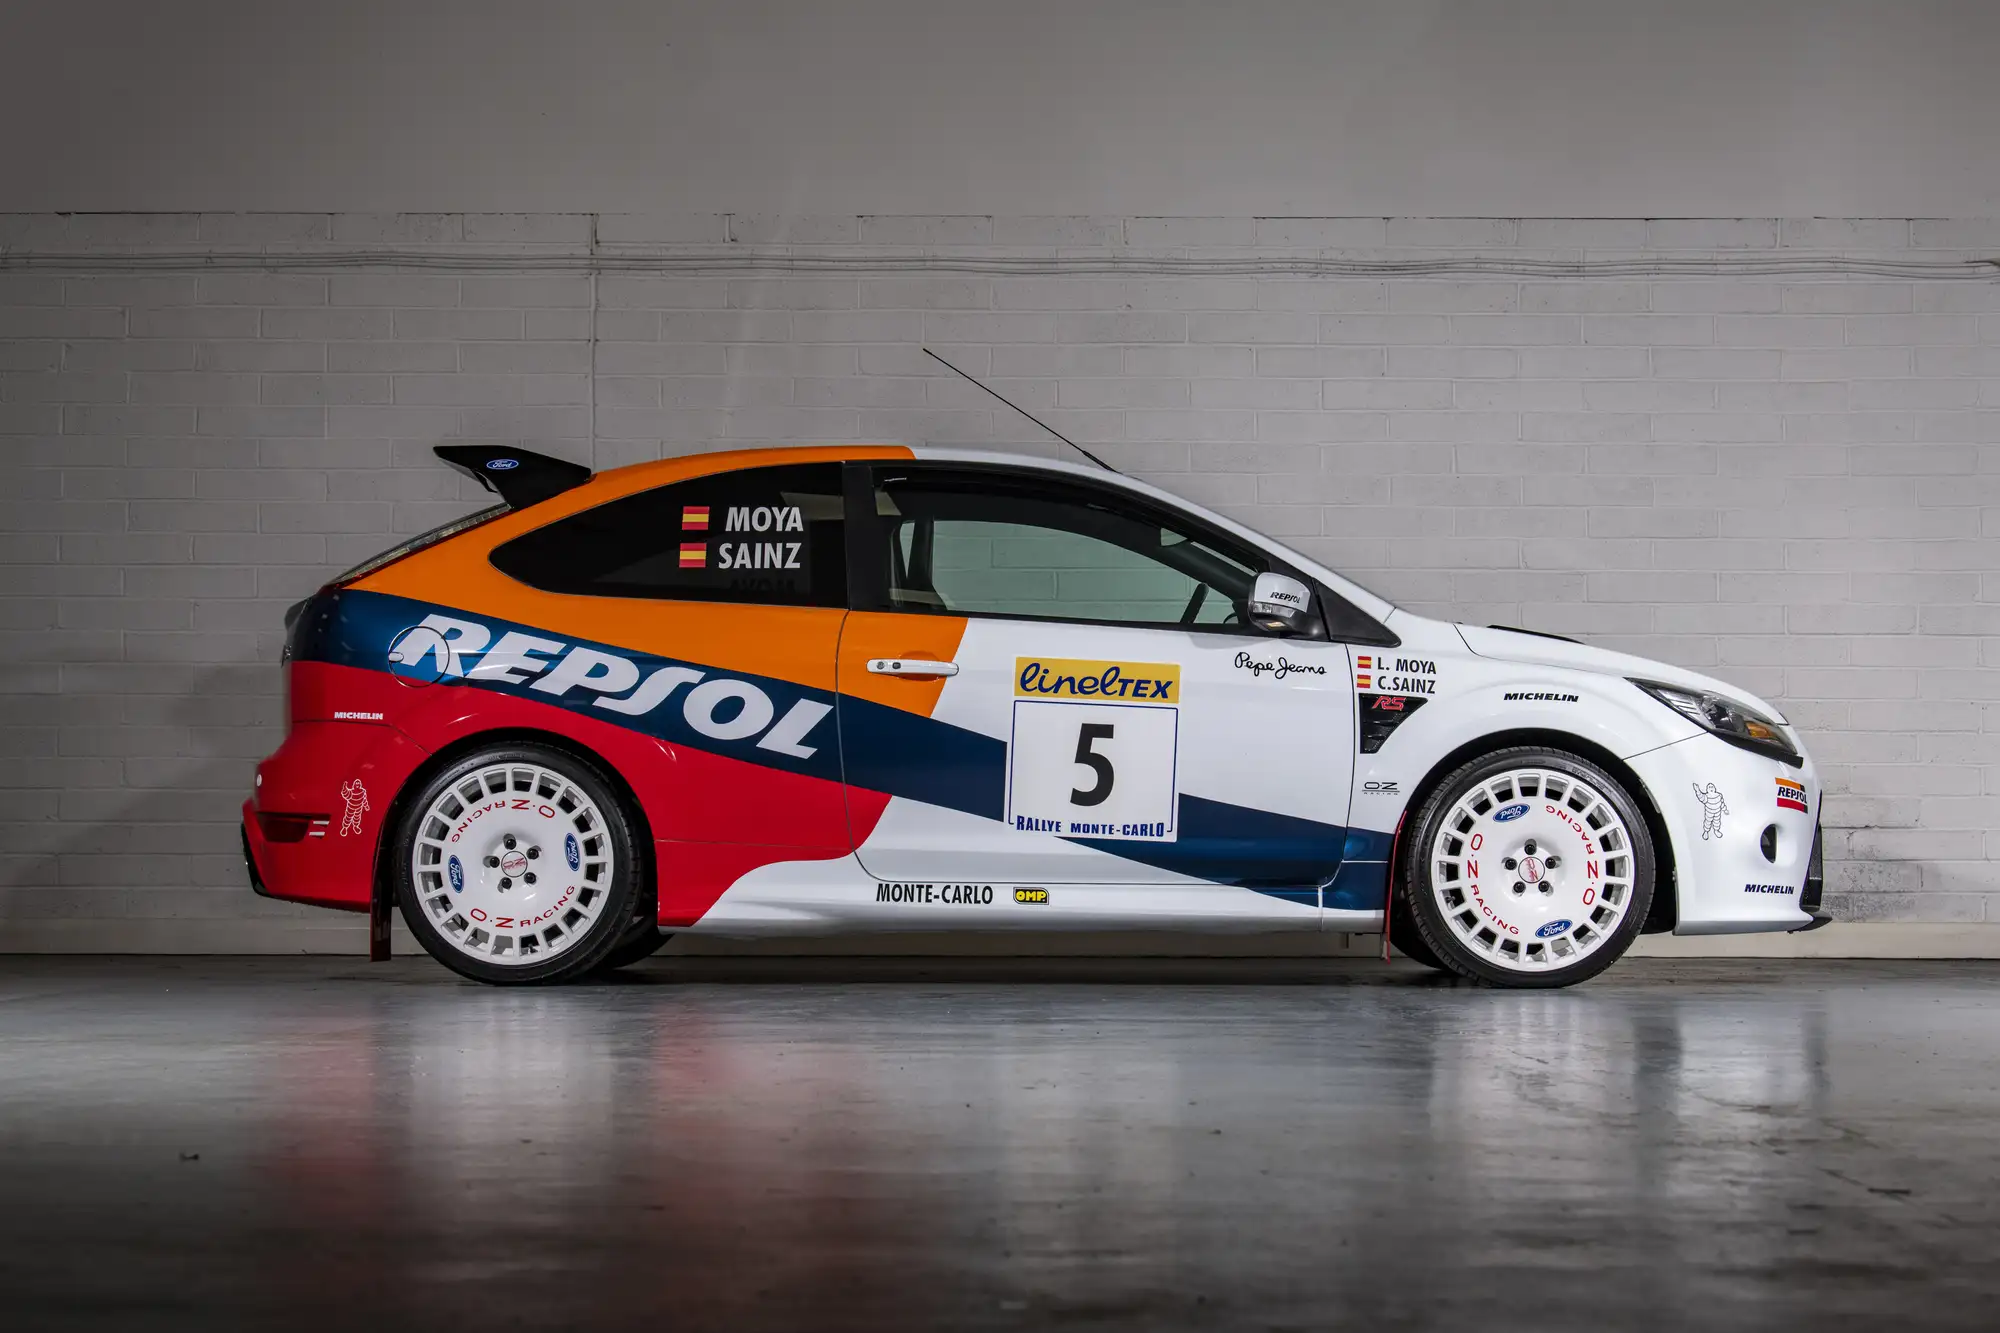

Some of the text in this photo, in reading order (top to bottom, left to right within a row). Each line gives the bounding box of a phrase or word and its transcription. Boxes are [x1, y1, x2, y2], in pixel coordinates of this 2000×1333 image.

[725, 506, 804, 532] MOYA
[718, 542, 802, 569] SAINZ
[1270, 592, 1300, 604] REPSOL
[1234, 652, 1327, 679] Pepe Jeans
[1378, 657, 1436, 674] L. MOYA
[398, 613, 834, 760] REPSOL
[1378, 675, 1436, 694] C.SAINZ
[1372, 696, 1407, 711] RS
[1503, 692, 1579, 703] MICHELIN
[334, 712, 383, 720] MICHELIN
[1070, 723, 1114, 807] 5
[1778, 786, 1808, 804] REPSOL
[451, 800, 506, 843] RACING
[1016, 815, 1165, 837] RALLYE MONTE-CARLO
[1545, 805, 1595, 854] RACING
[876, 884, 993, 904] MONTE-CARLO
[1015, 889, 1047, 902] OMP
[1744, 883, 1795, 895] MICHELIN
[519, 885, 575, 928] RACING
[1470, 884, 1519, 935] RACING
